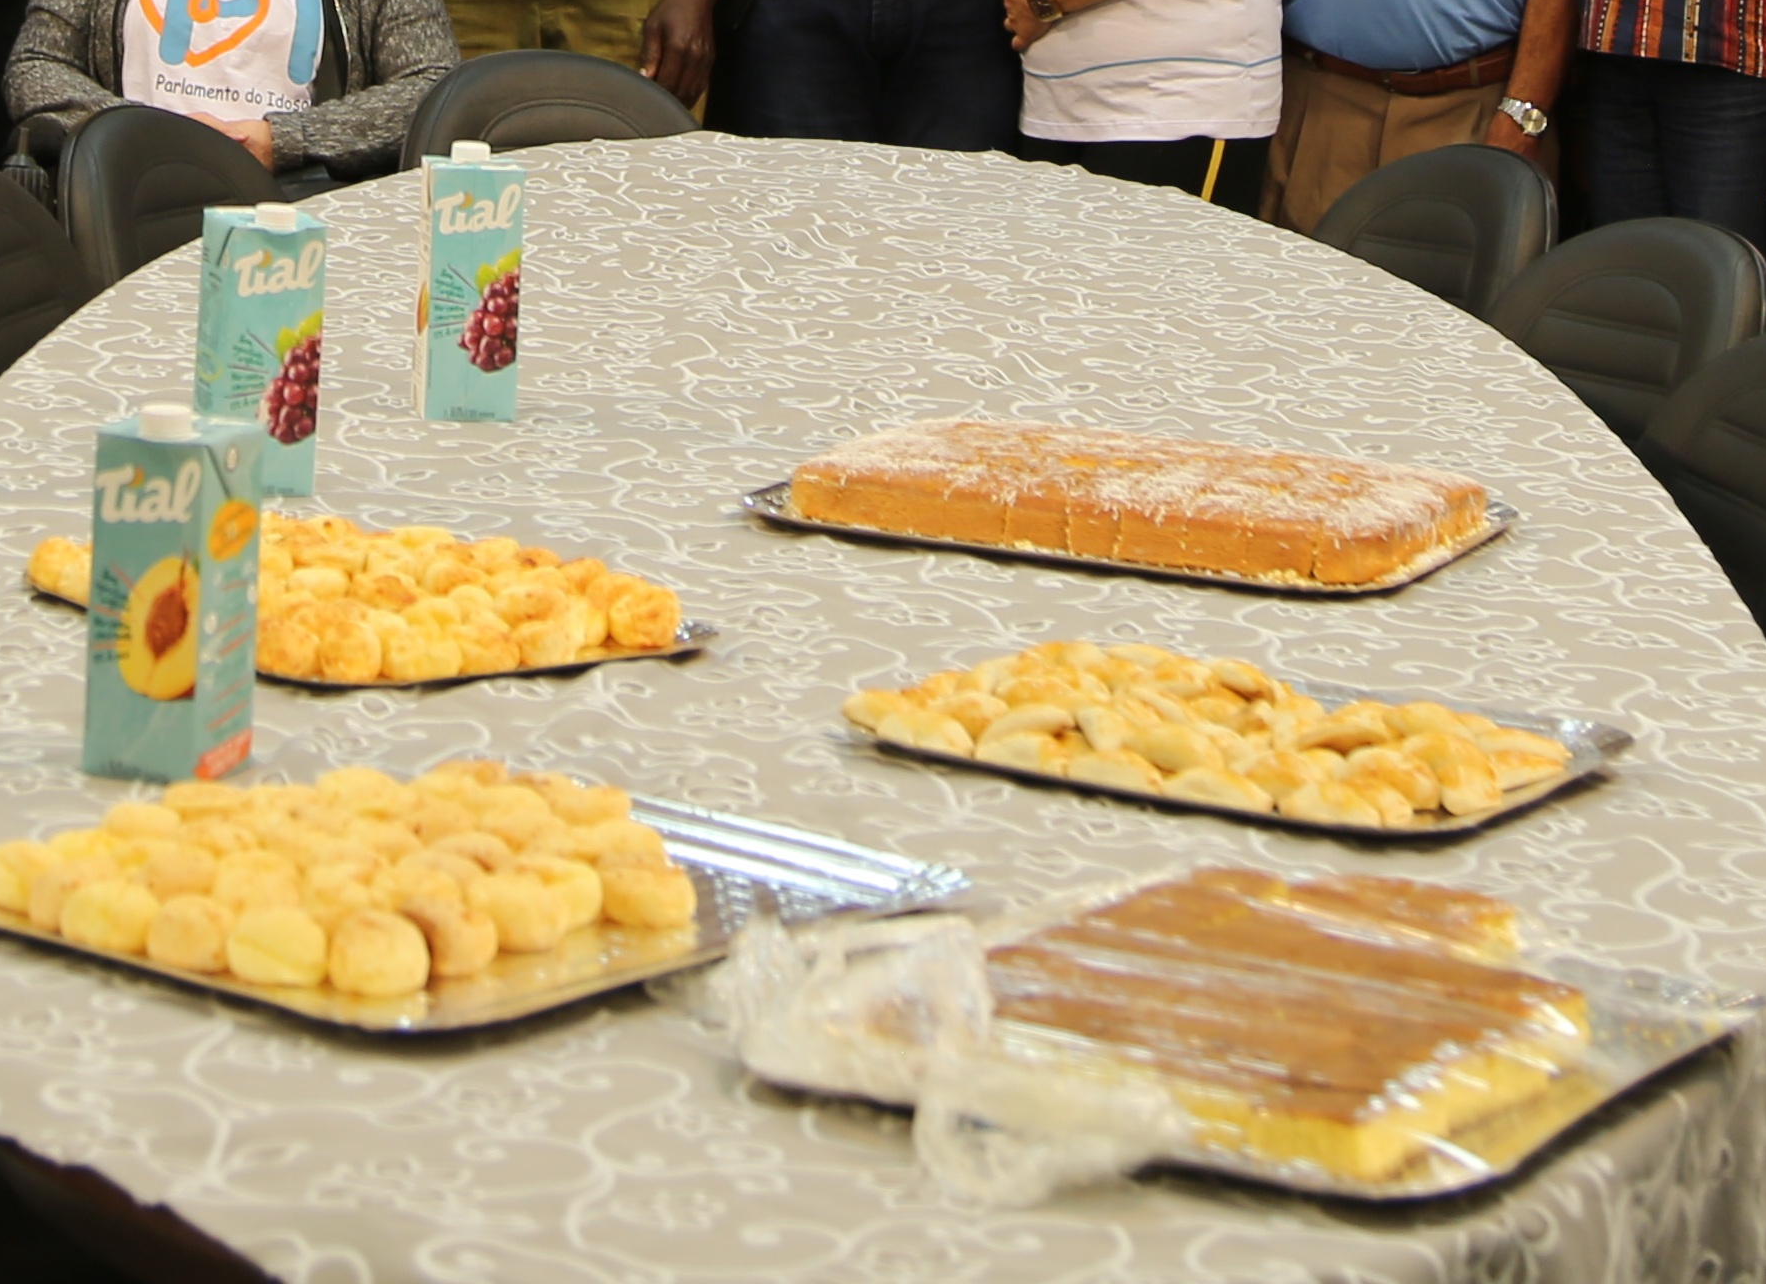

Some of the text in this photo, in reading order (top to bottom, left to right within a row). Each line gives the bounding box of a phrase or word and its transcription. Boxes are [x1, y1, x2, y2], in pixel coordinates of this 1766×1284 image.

[156, 74, 311, 112] Parlamento do Idoso
[435, 184, 522, 235] Tial
[233, 241, 325, 298] Tial
[95, 459, 202, 524] Tial
